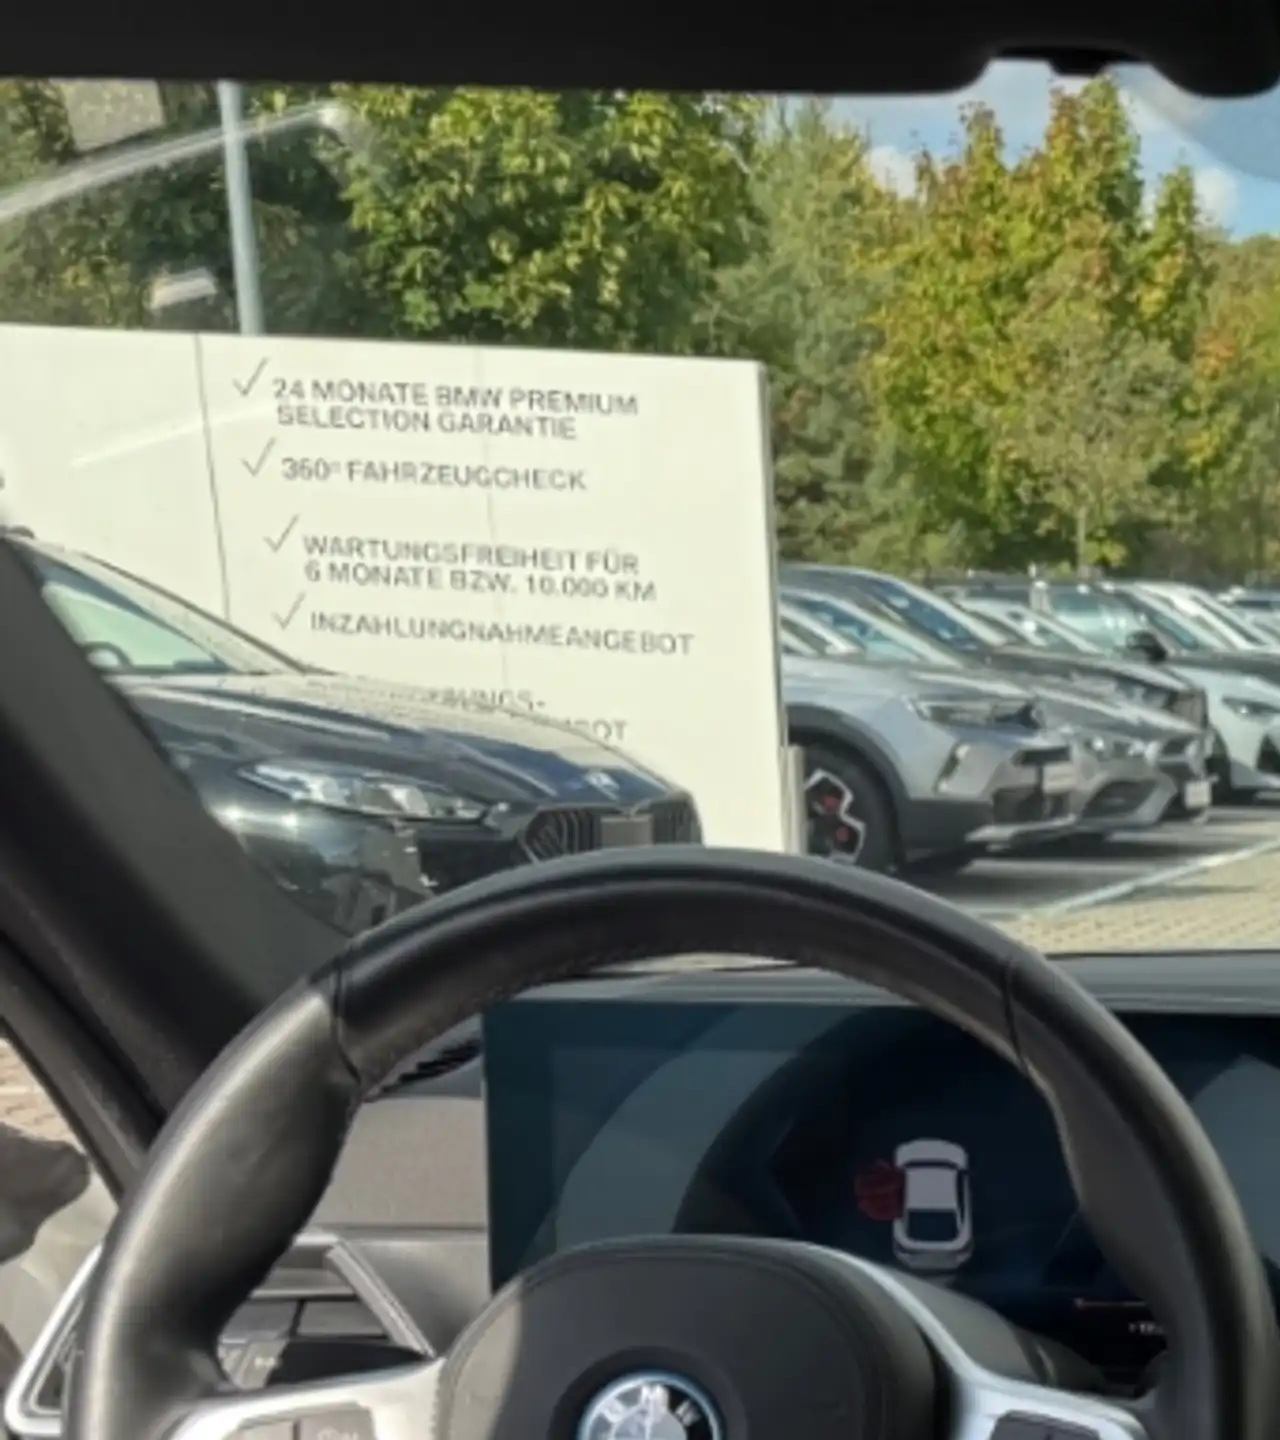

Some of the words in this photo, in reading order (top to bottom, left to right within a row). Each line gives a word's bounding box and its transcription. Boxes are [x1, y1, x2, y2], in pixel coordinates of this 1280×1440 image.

[273, 378, 305, 400] 24
[311, 379, 429, 406] MONATE
[434, 385, 501, 409] BMW
[509, 387, 638, 416] PREMIUM
[277, 404, 431, 432] SELECTION
[437, 411, 577, 440] GARANTIE
[280, 457, 340, 482] 360°
[347, 459, 588, 491] FAHRZEUGCHECK
[302, 536, 581, 572] WARTUNGSFREIHEIT
[585, 546, 640, 576] FÜR
[304, 558, 321, 582] 6
[328, 562, 444, 590] MONATE
[450, 569, 517, 594] BZW.
[526, 573, 609, 598] 10.000
[614, 579, 658, 601] KM
[310, 610, 695, 655] INZAHLUNGNAHMEANGEBOT
